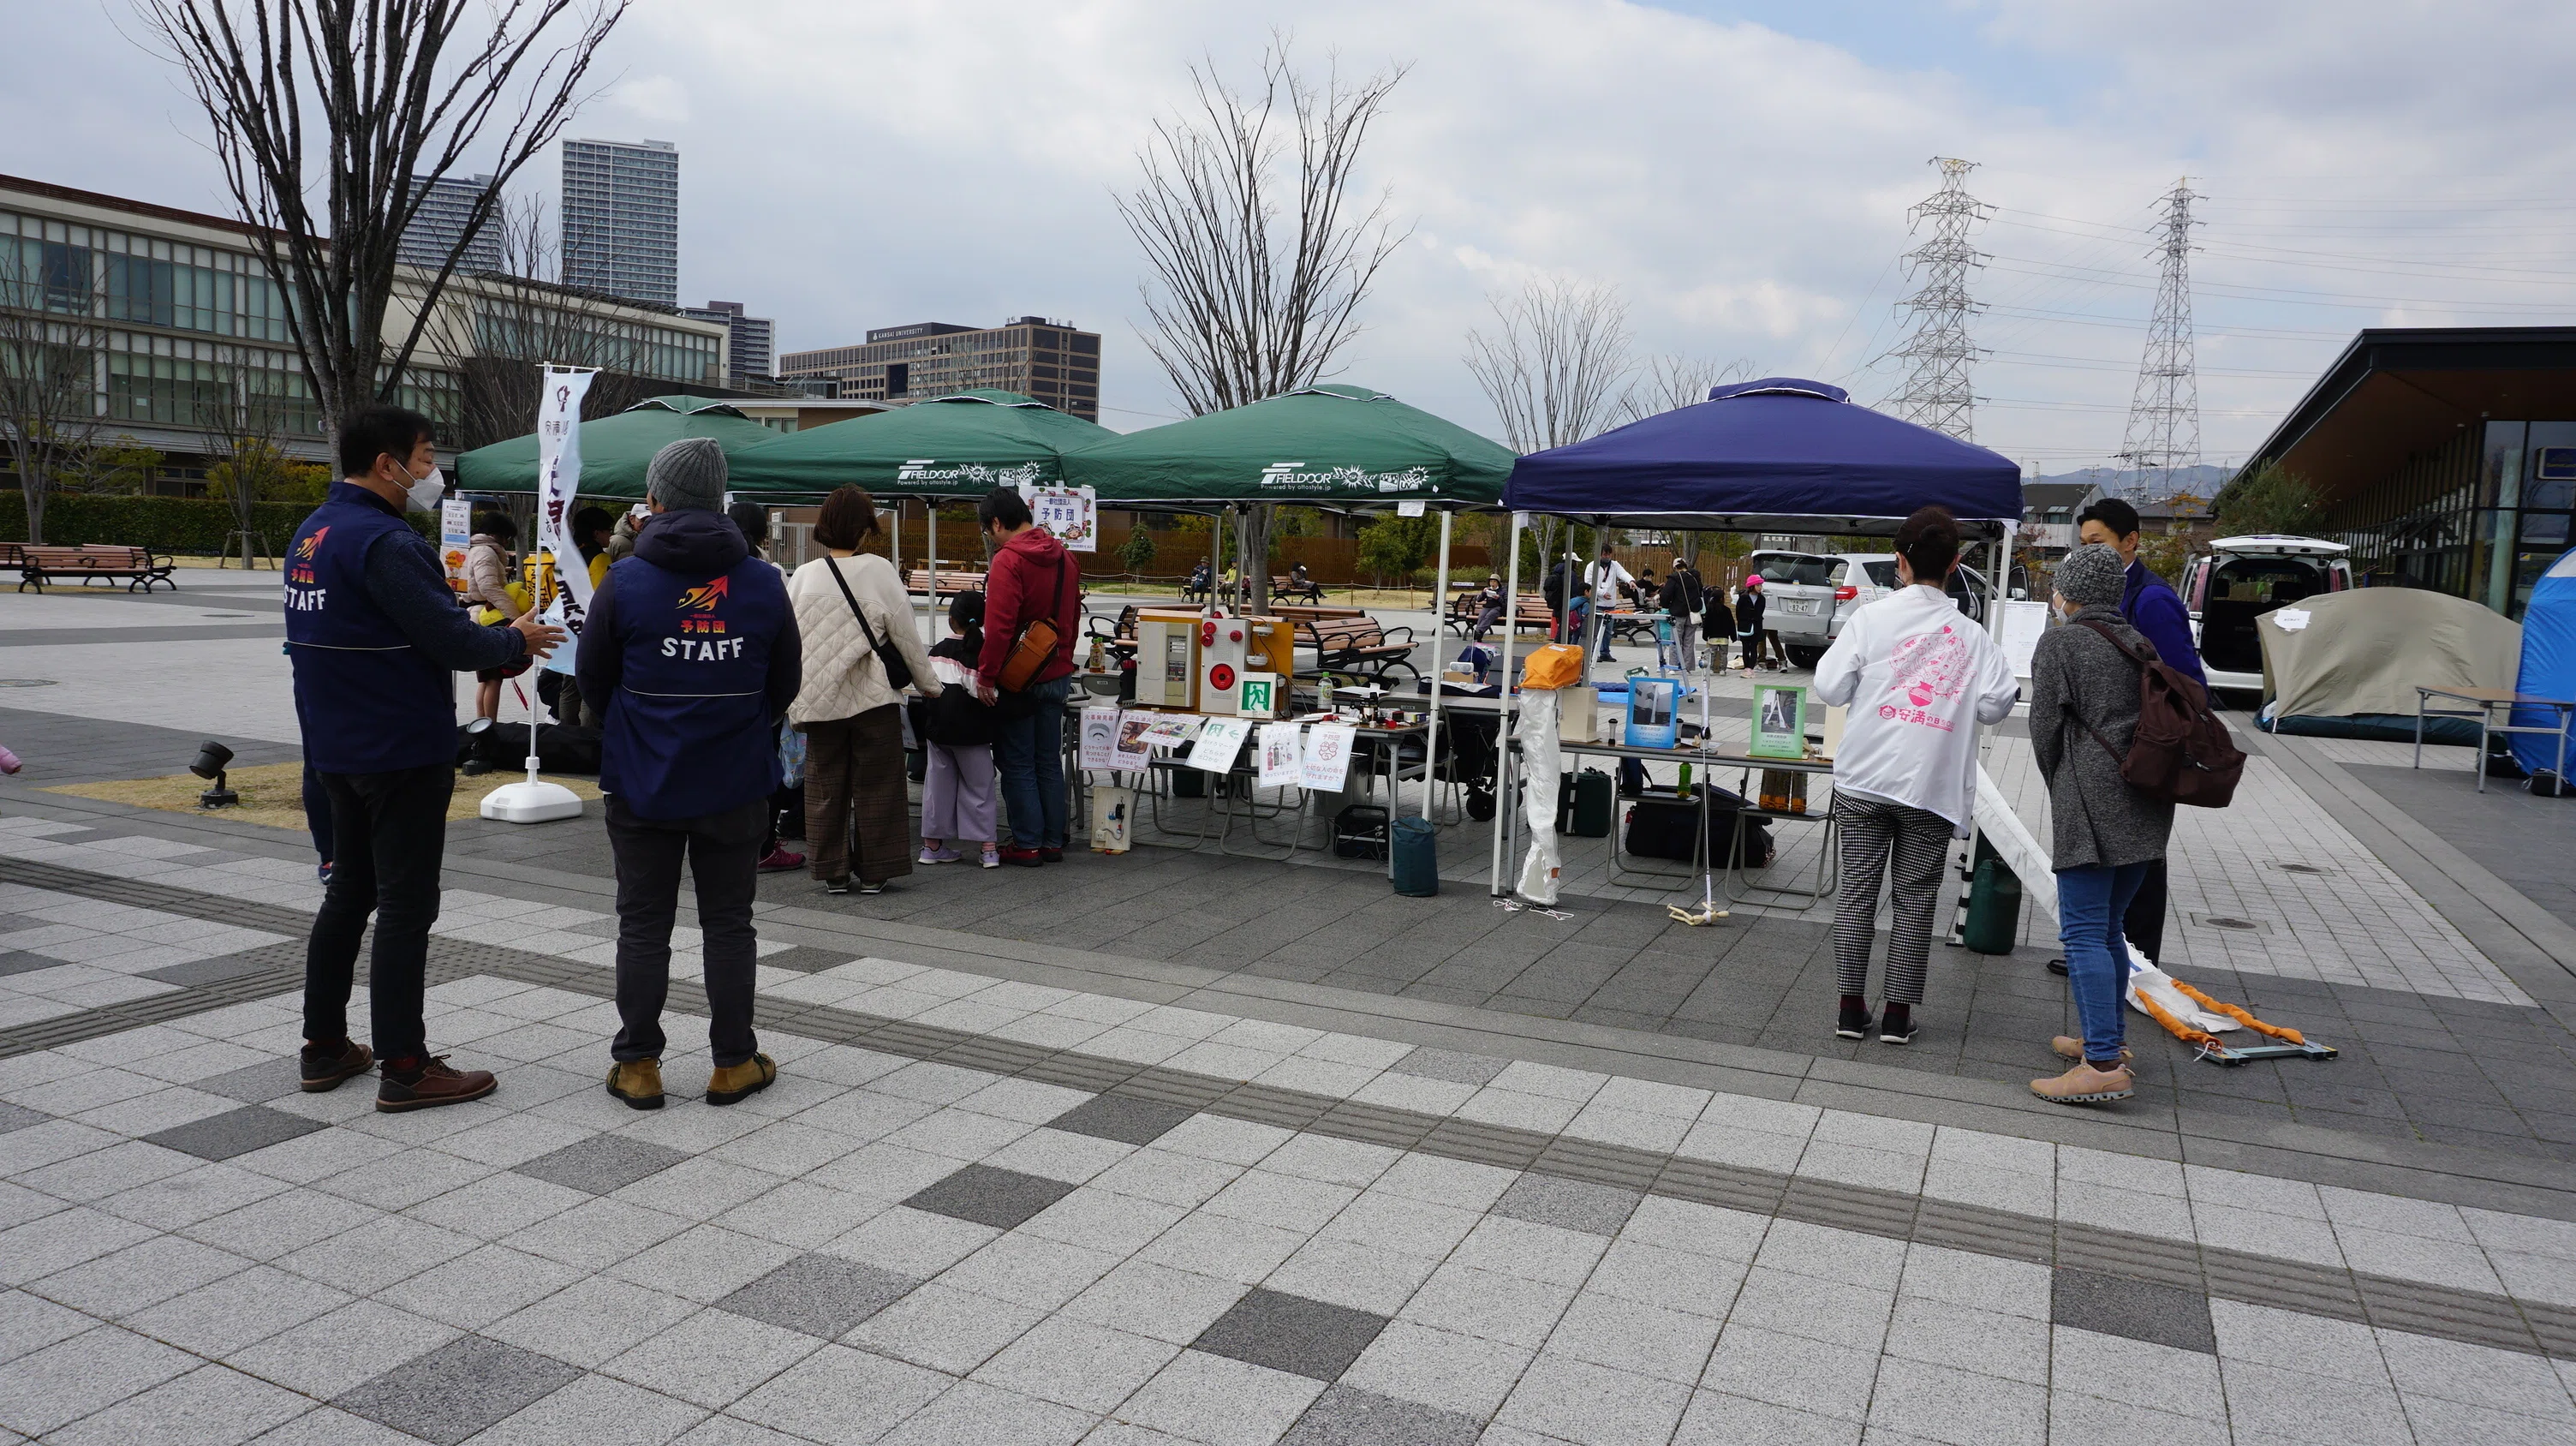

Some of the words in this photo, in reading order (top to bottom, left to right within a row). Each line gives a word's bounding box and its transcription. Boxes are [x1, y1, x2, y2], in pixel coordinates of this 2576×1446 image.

[896, 328, 923, 337] UNIVERSITY
[910, 470, 958, 480] FIELDOOR
[1276, 473, 1332, 484] FIELDOOR
[1041, 507, 1075, 521] 予防団
[283, 584, 326, 611] STAFF
[680, 619, 725, 634] 予防団
[661, 636, 744, 661] STAFF
